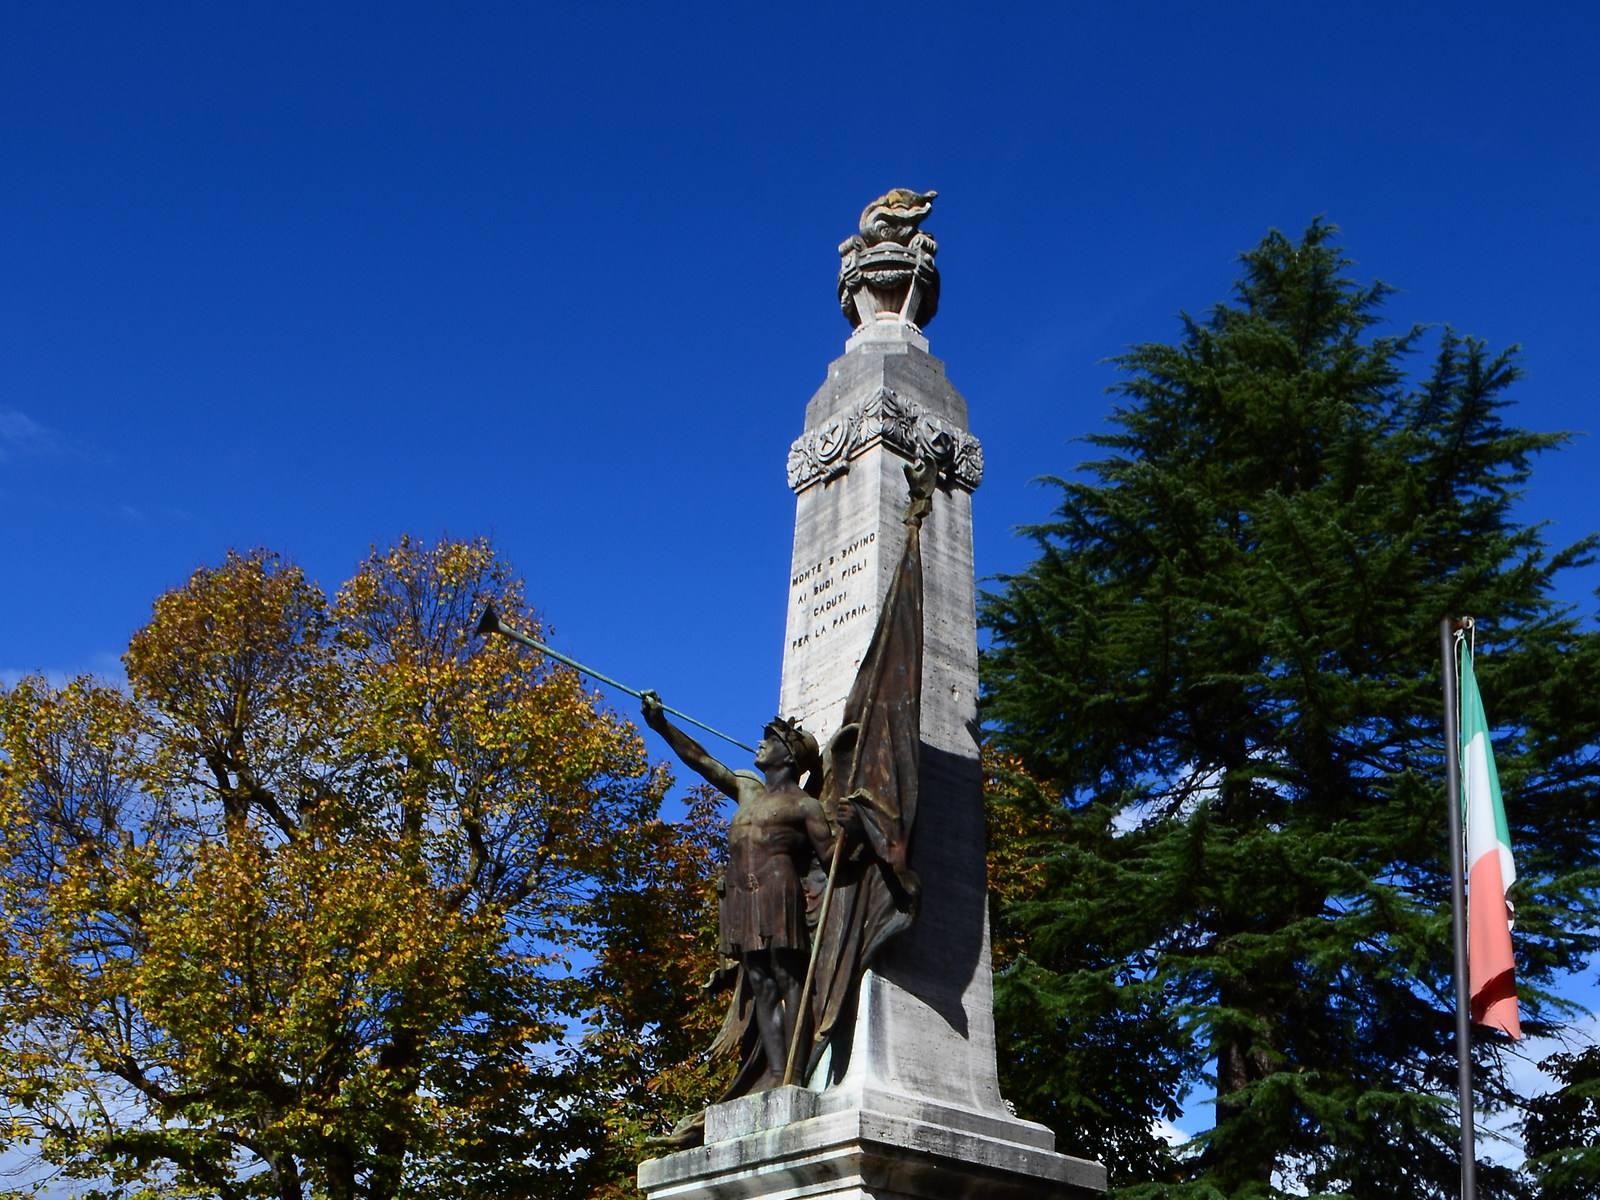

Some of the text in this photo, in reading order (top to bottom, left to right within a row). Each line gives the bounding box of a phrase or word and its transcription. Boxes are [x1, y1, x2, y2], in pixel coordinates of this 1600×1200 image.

[792, 563, 822, 587] MONTE
[798, 593, 807, 604] AI
[842, 559, 867, 580] FIGLI
[813, 592, 847, 617] CADUTI
[792, 604, 867, 650] PER LA PATRIA
